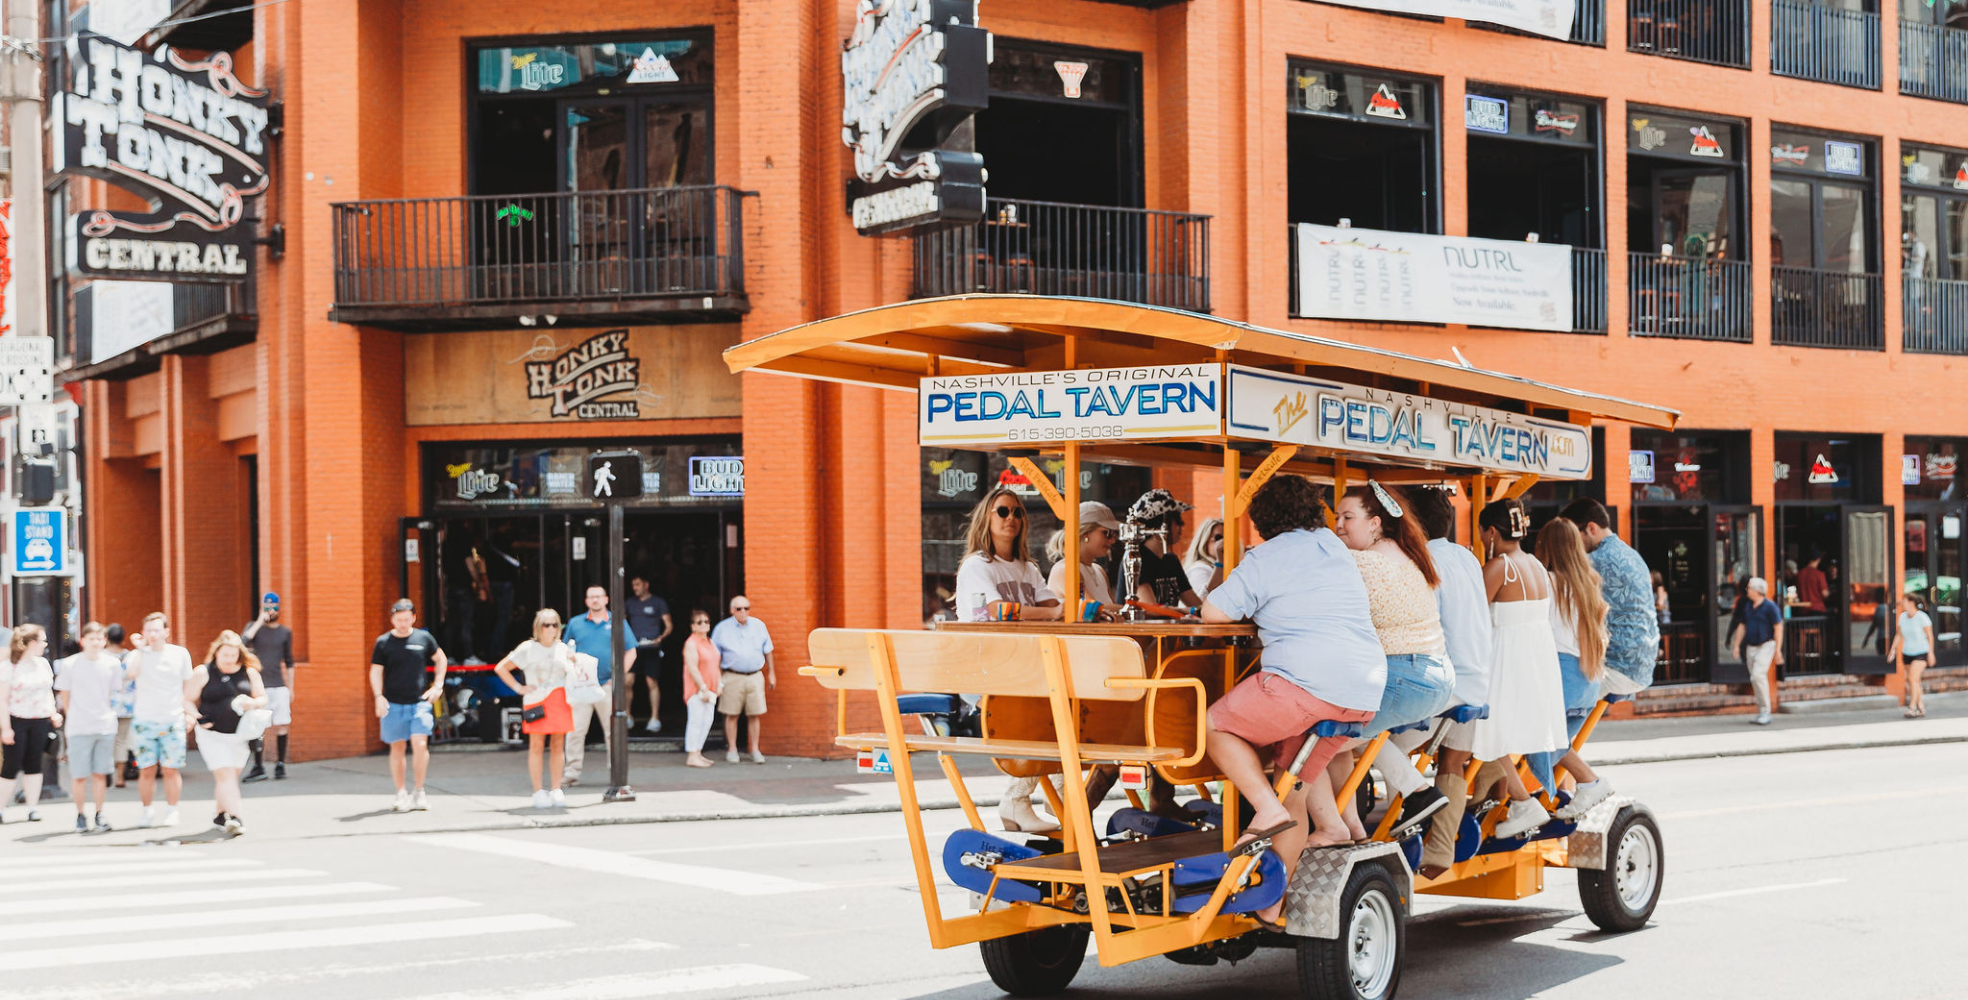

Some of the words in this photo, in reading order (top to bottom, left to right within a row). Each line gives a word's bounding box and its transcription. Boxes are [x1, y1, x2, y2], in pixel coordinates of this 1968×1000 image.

[89, 38, 268, 155] HONKY
[67, 92, 224, 208] TONK
[86, 238, 247, 274] CENTRAL
[528, 332, 625, 397] HONKY
[932, 372, 1077, 390] NASHVILLE'S
[1087, 366, 1210, 383] ORIGINAL
[546, 361, 637, 416] TONK
[928, 389, 1061, 423] PEDAL
[1065, 380, 1216, 418] TAVERN
[1365, 388, 1513, 423] NASHVILLE
[578, 402, 639, 417] CENTRAL
[1008, 425, 1123, 441] 615-390-5038
[1321, 398, 1436, 451] PEDAL
[1451, 417, 1549, 467] TAVERN
[700, 459, 744, 475] BUD
